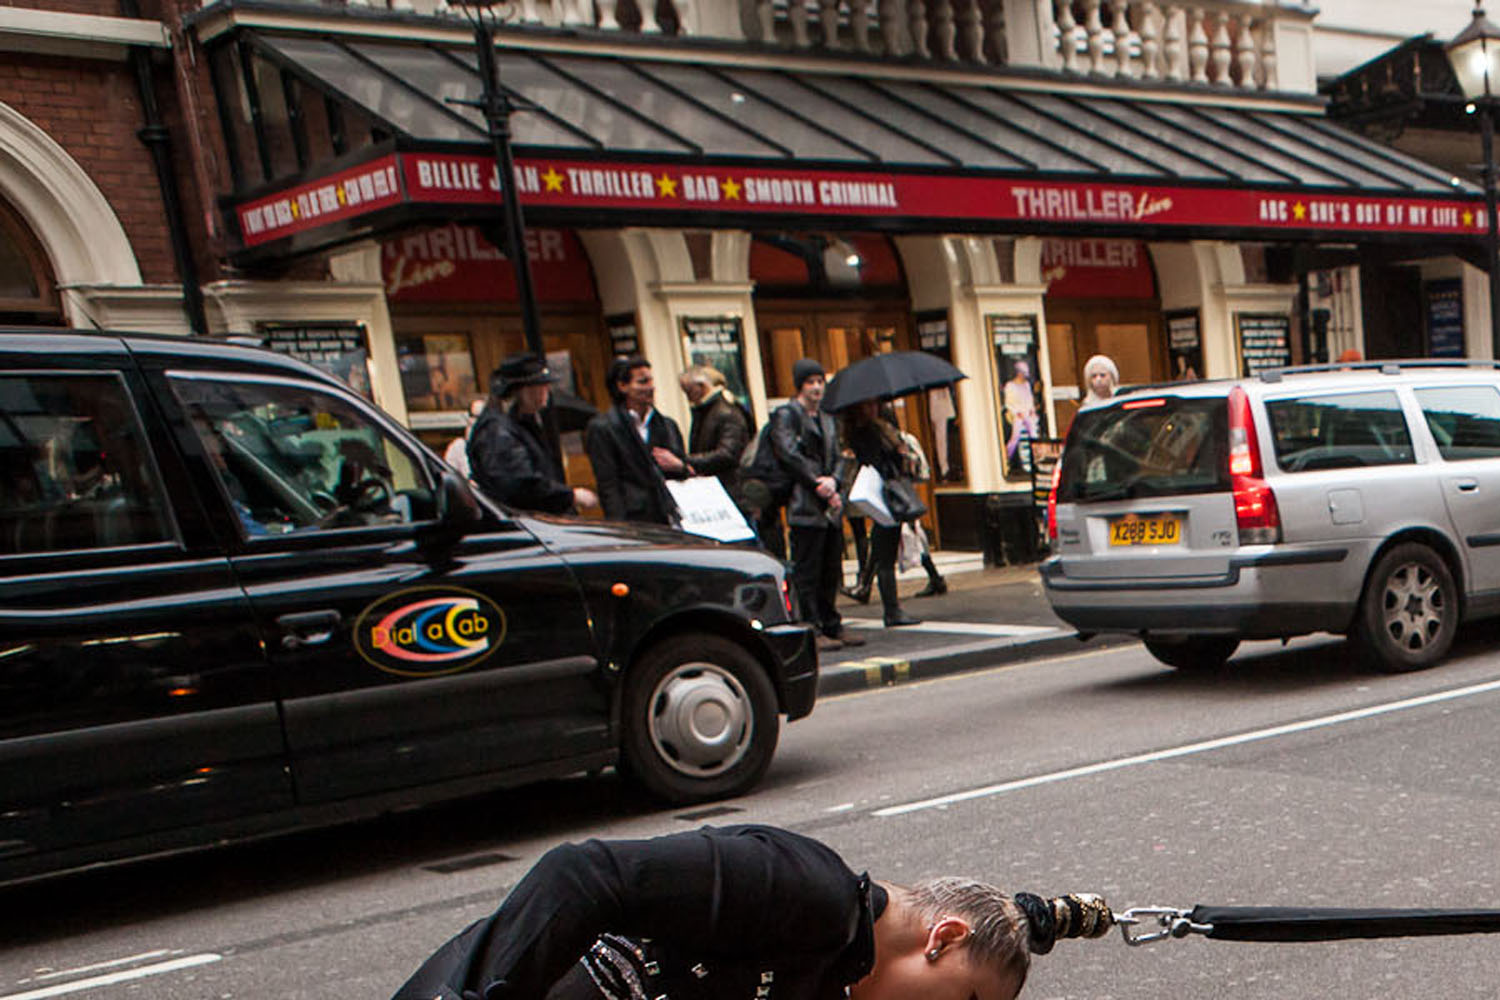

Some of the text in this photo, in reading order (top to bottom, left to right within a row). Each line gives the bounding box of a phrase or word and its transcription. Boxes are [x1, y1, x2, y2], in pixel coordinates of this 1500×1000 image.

[417, 160, 482, 191] BILLIE
[489, 164, 541, 193] JAN
[567, 168, 655, 199] THRILLER
[682, 175, 720, 202] BAD
[744, 177, 898, 208] SMOOTH CRIMINAL
[1011, 186, 1135, 219] THRILLER
[385, 225, 566, 262] THRILER
[371, 620, 418, 649] Dial
[427, 623, 444, 640] a
